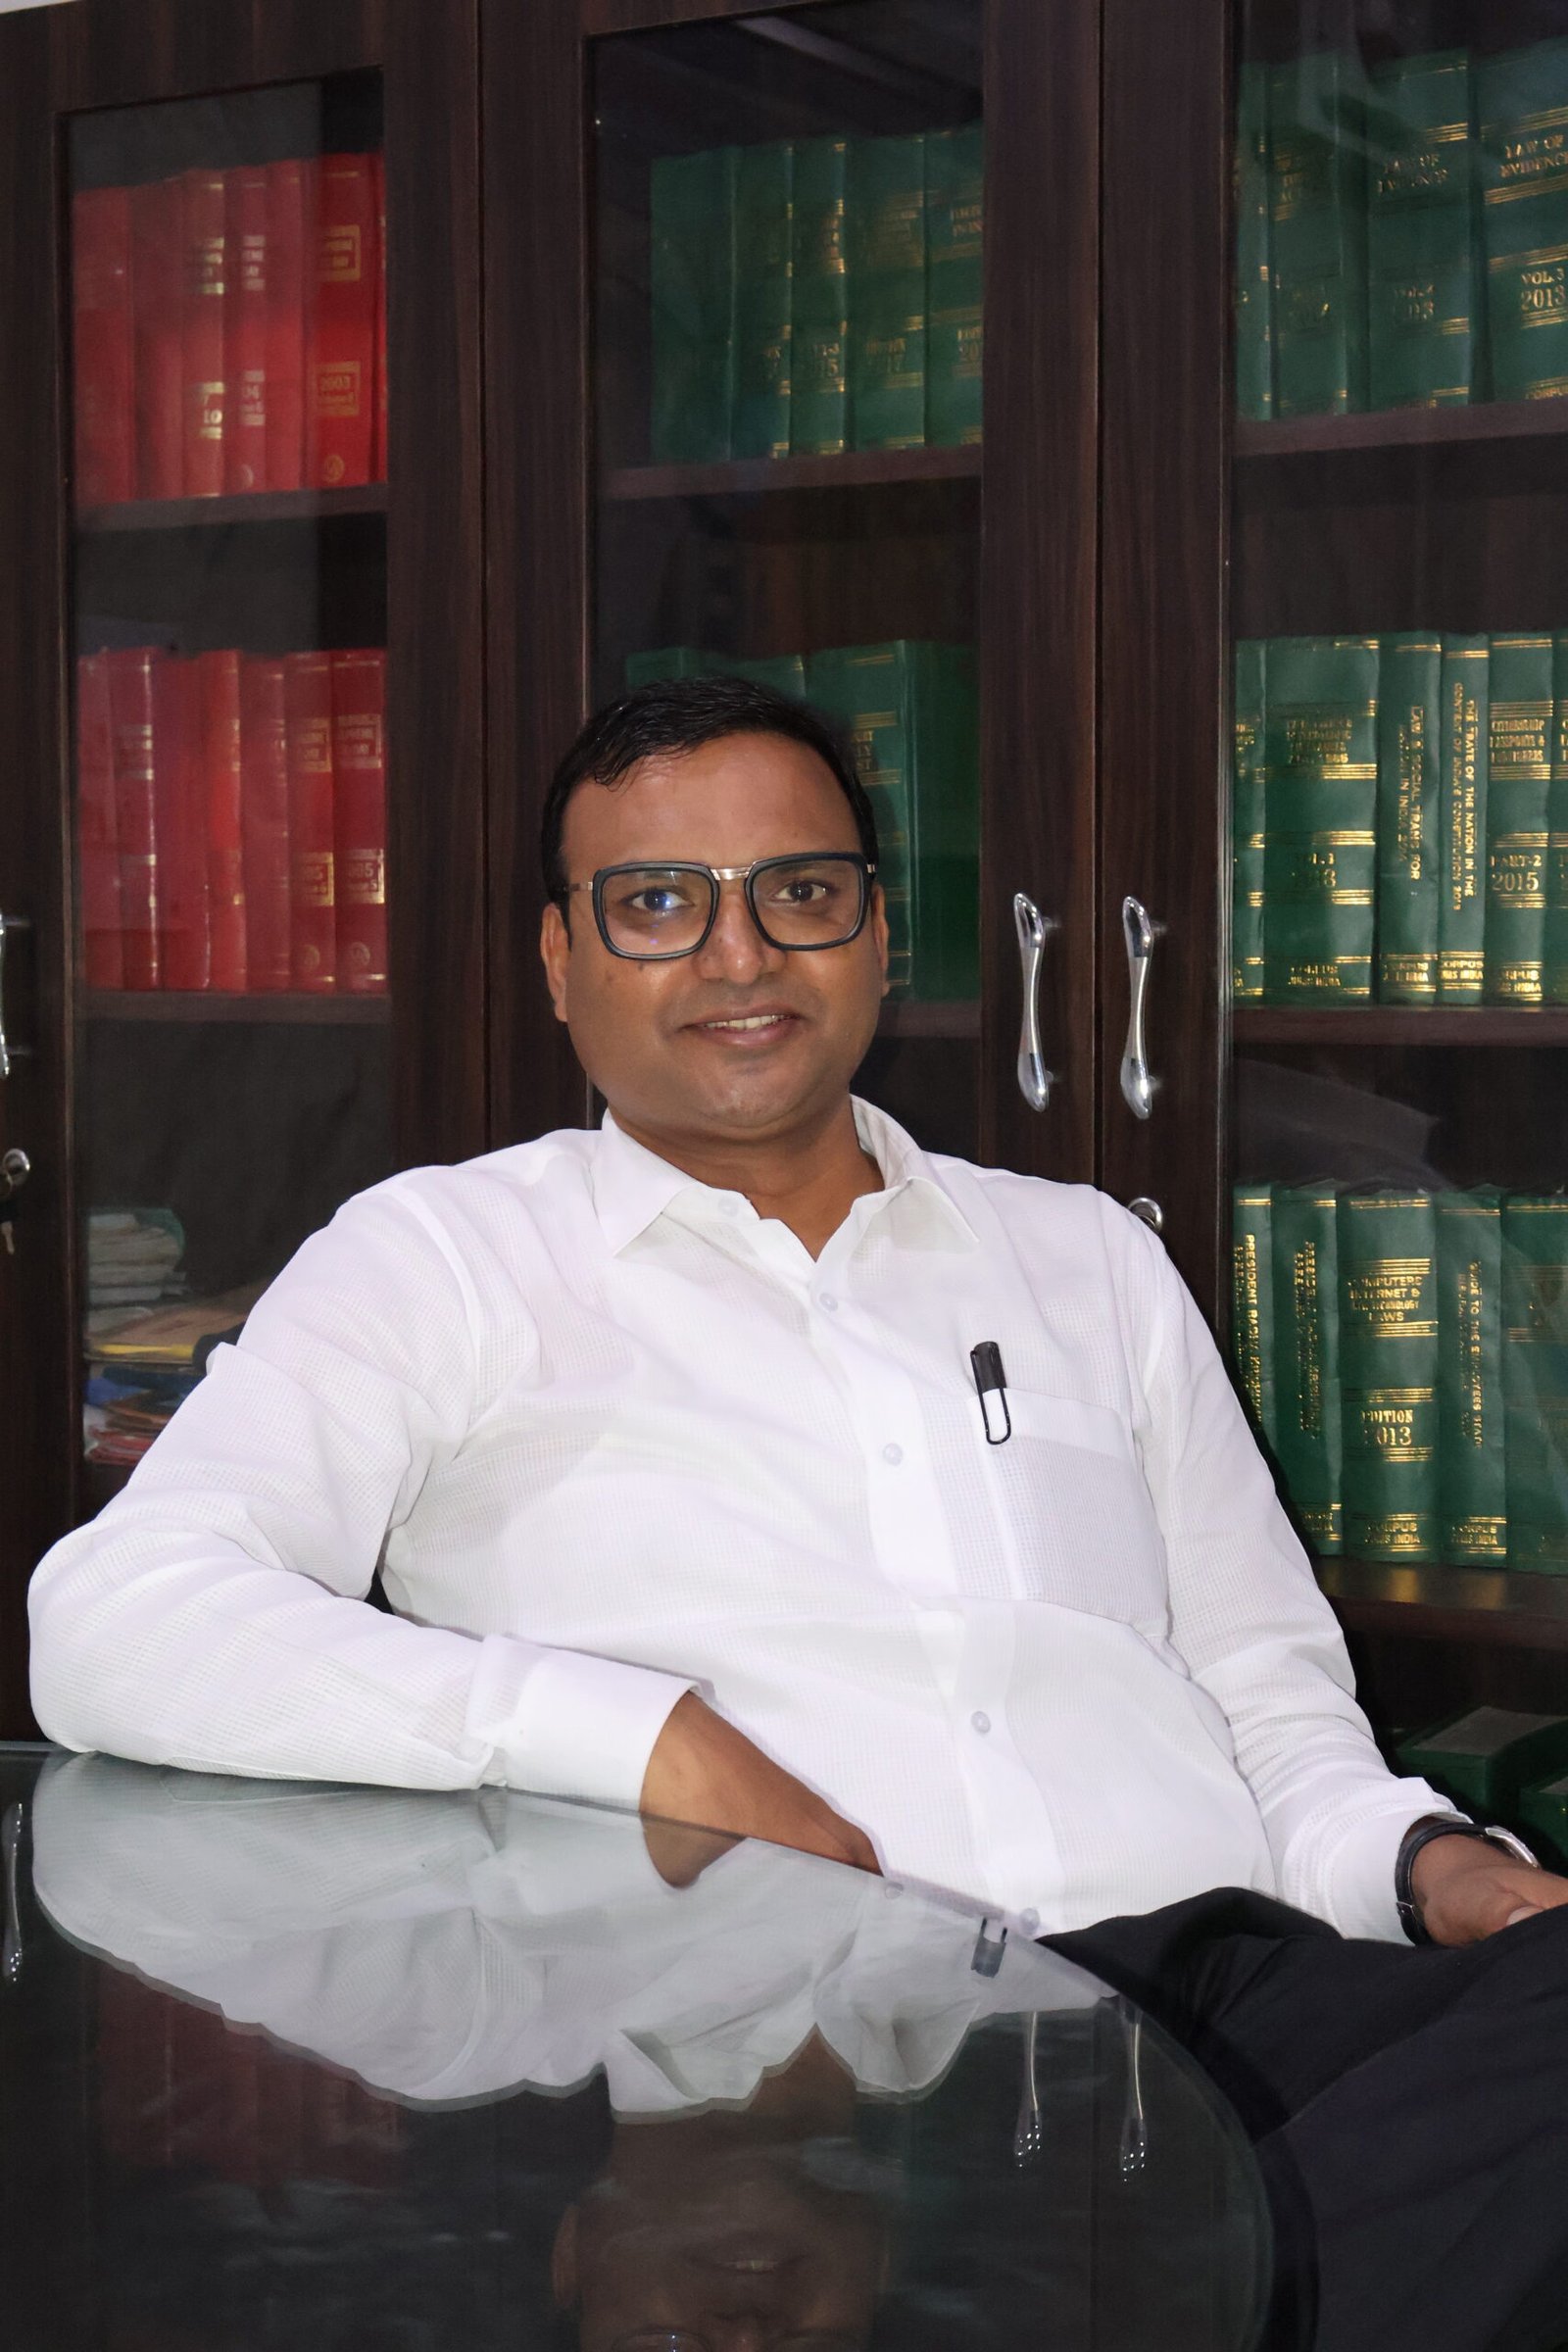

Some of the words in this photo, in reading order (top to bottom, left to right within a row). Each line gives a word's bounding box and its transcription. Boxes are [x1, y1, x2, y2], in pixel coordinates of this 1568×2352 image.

[1520, 284, 1566, 311] 2013
[1465, 765, 1475, 781] OF
[1465, 787, 1475, 808] THE
[1465, 812, 1475, 855] NATION
[1465, 858, 1474, 869] IN
[1465, 874, 1474, 897] THE
[1491, 871, 1540, 892] 2015
[1246, 1234, 1257, 1305] PRESIDENT
[1470, 1300, 1481, 1315] TO
